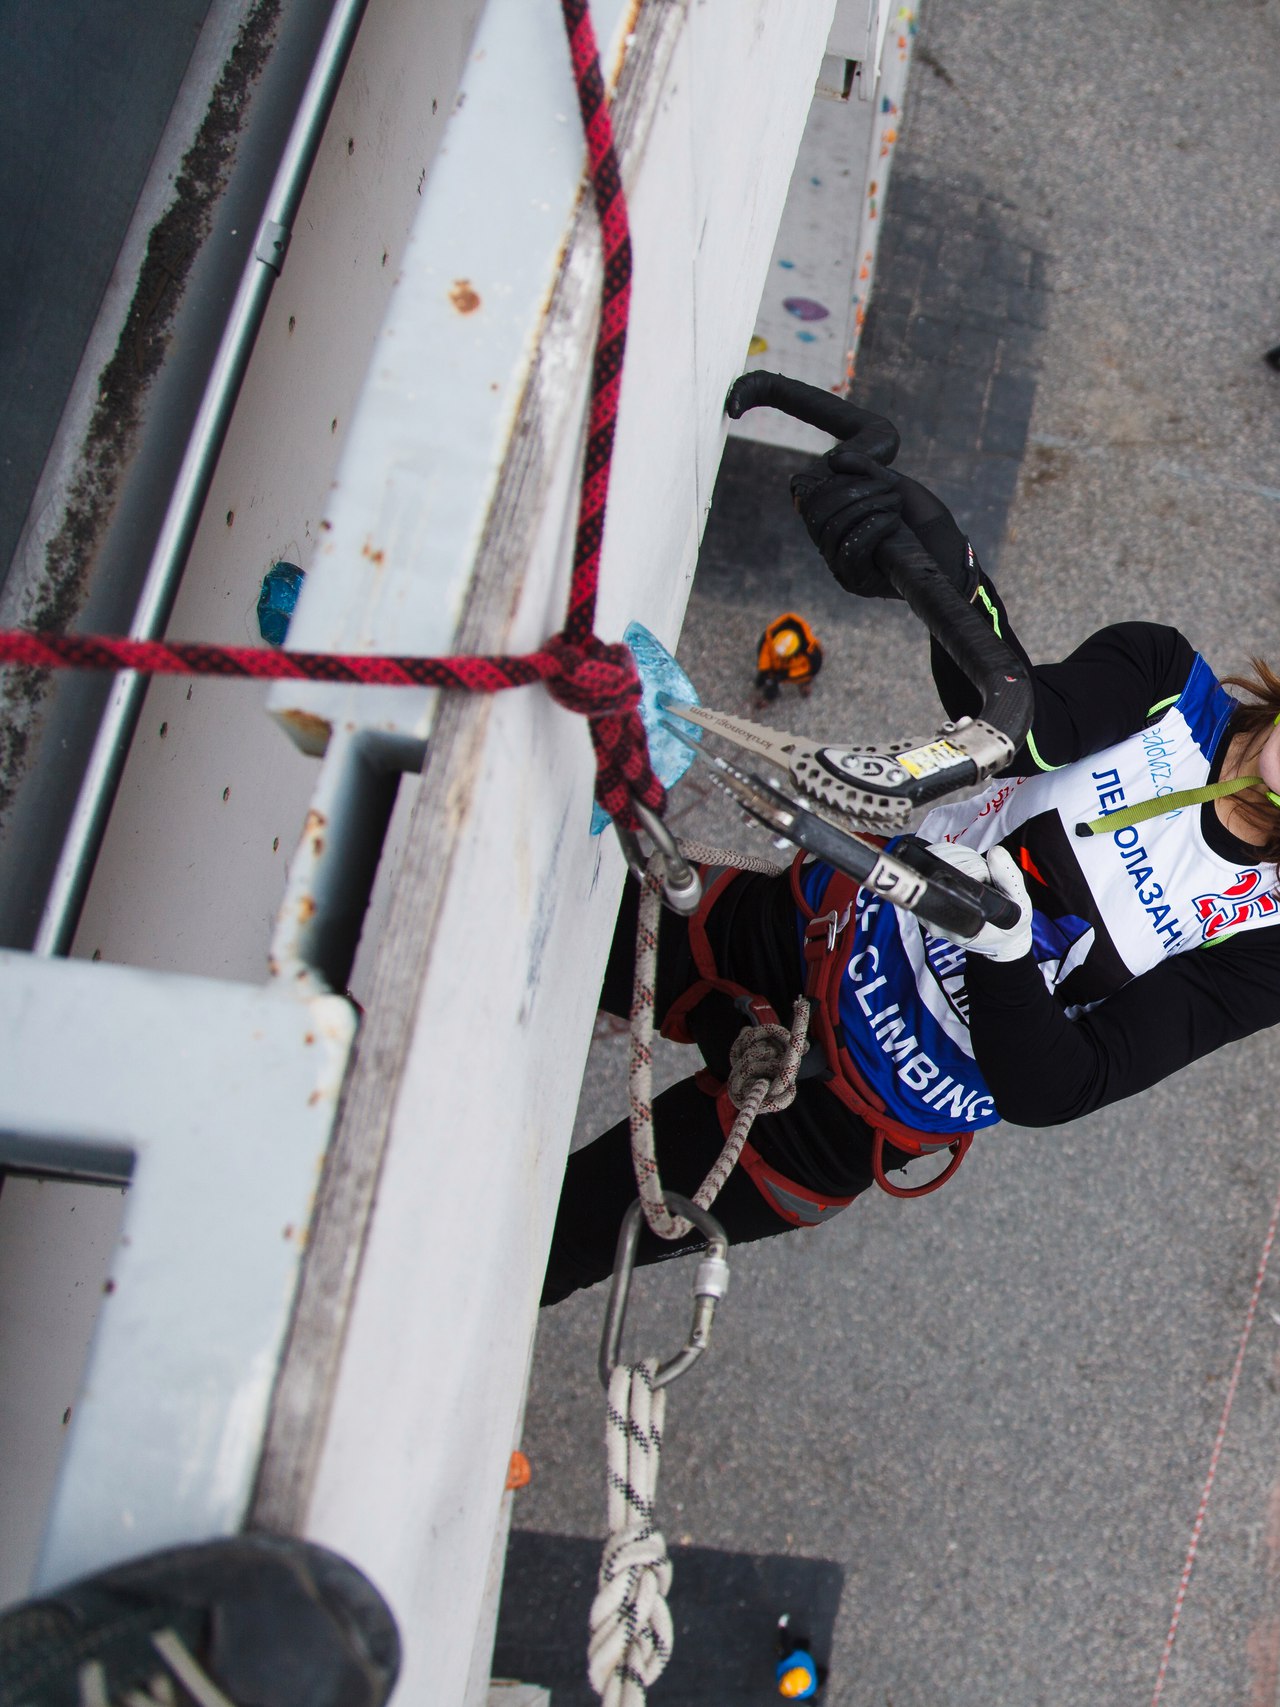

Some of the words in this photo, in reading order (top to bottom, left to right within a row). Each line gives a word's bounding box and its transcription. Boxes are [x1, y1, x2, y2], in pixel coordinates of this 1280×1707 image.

[689, 706, 773, 749] krukonogi.com
[1192, 868, 1279, 941] 25
[848, 944, 994, 1122] CLIMBING
